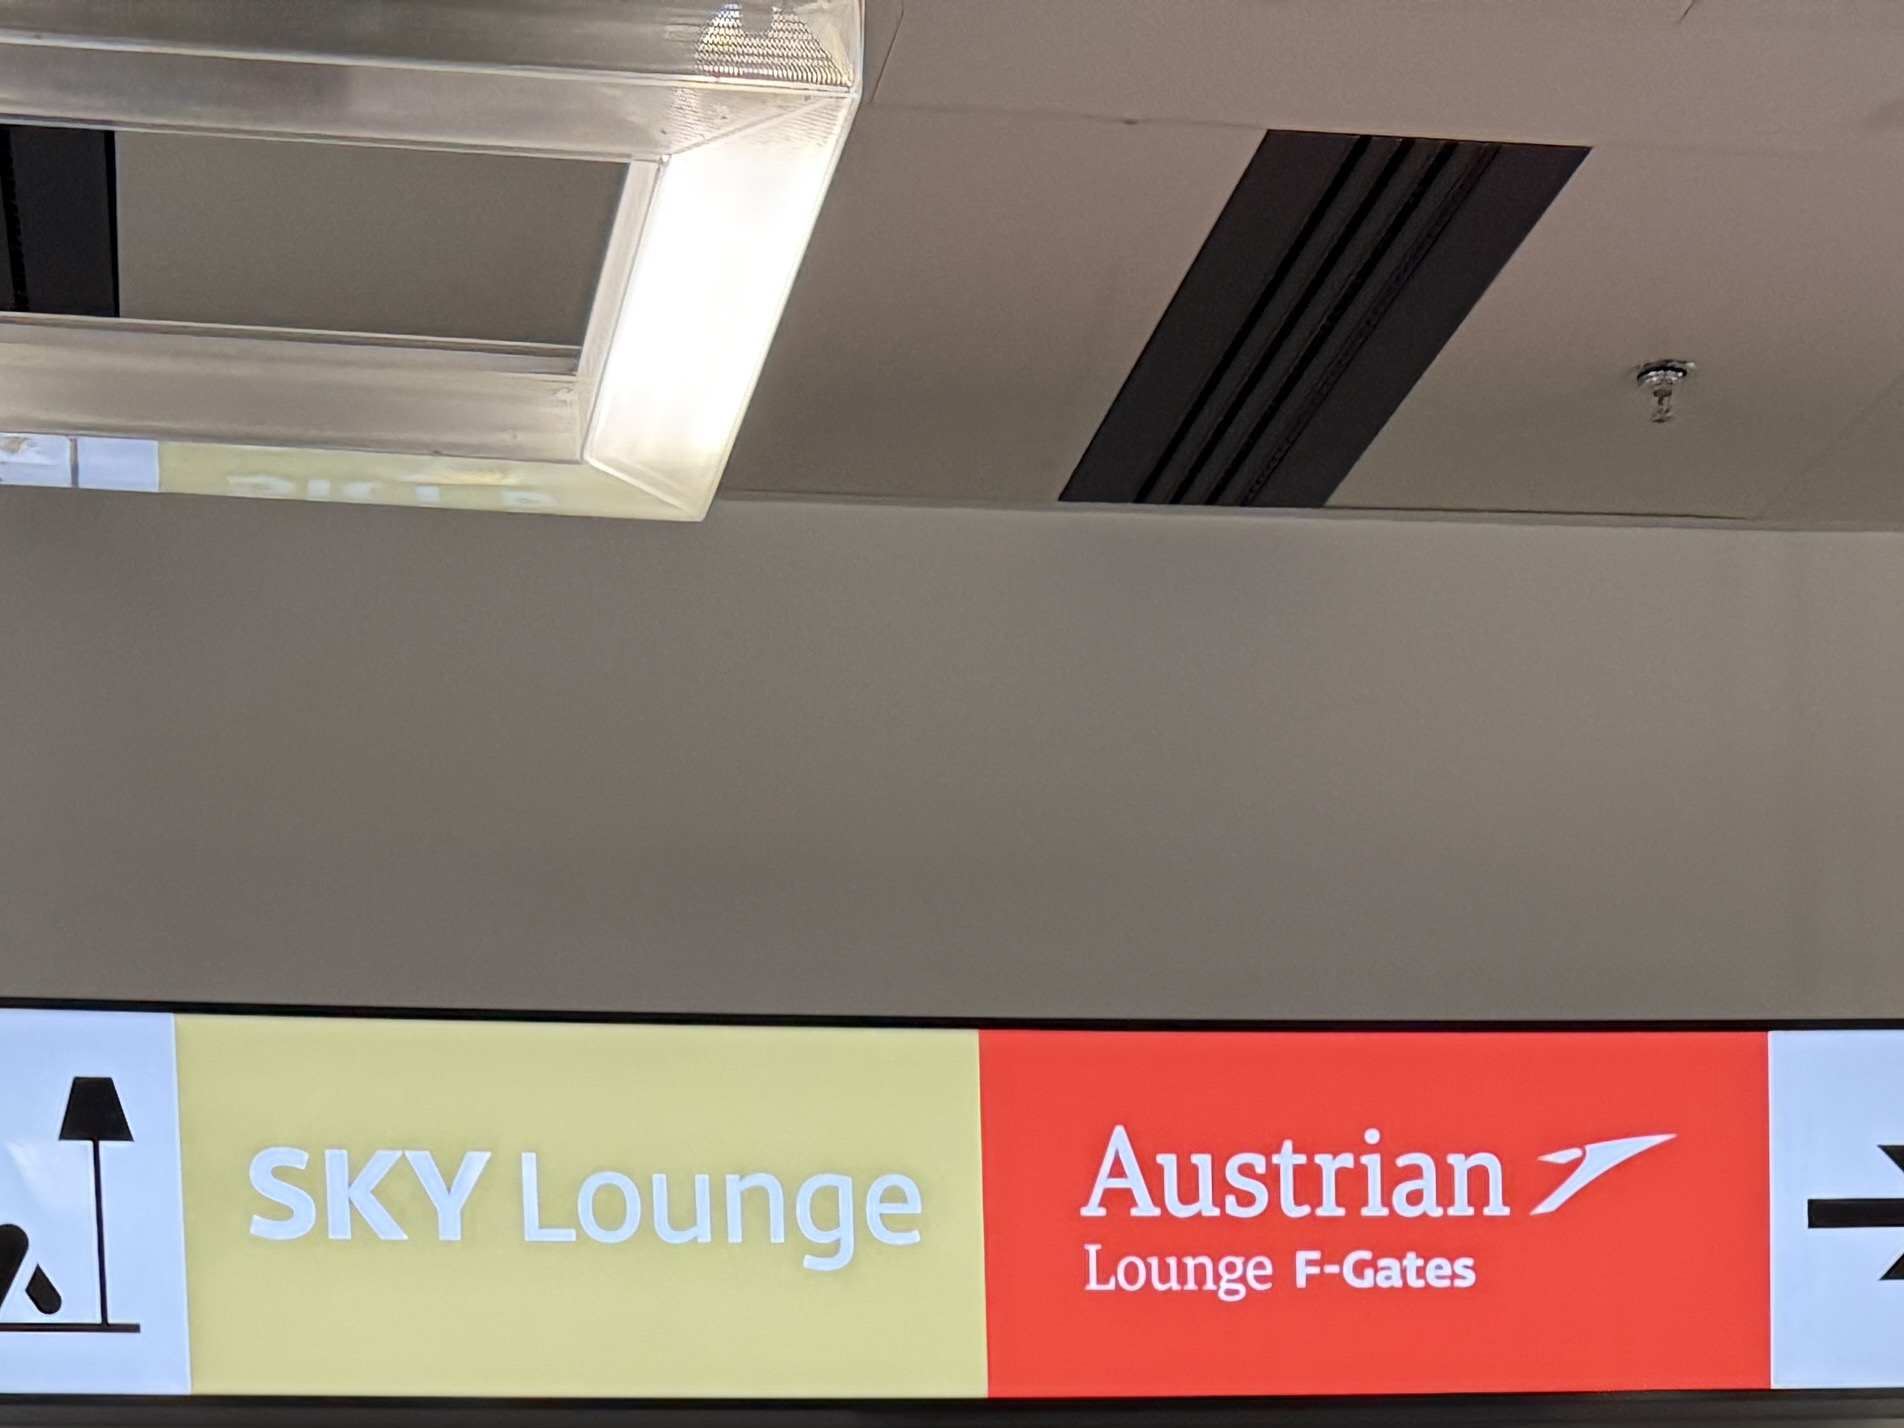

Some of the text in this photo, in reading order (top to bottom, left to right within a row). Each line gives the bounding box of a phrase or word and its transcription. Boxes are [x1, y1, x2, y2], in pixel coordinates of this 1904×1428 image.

[248, 1146, 923, 1272] SKY Lounge
[1080, 1124, 1511, 1219] Austrian
[1084, 1243, 1477, 1301] Lounge F-Gates
